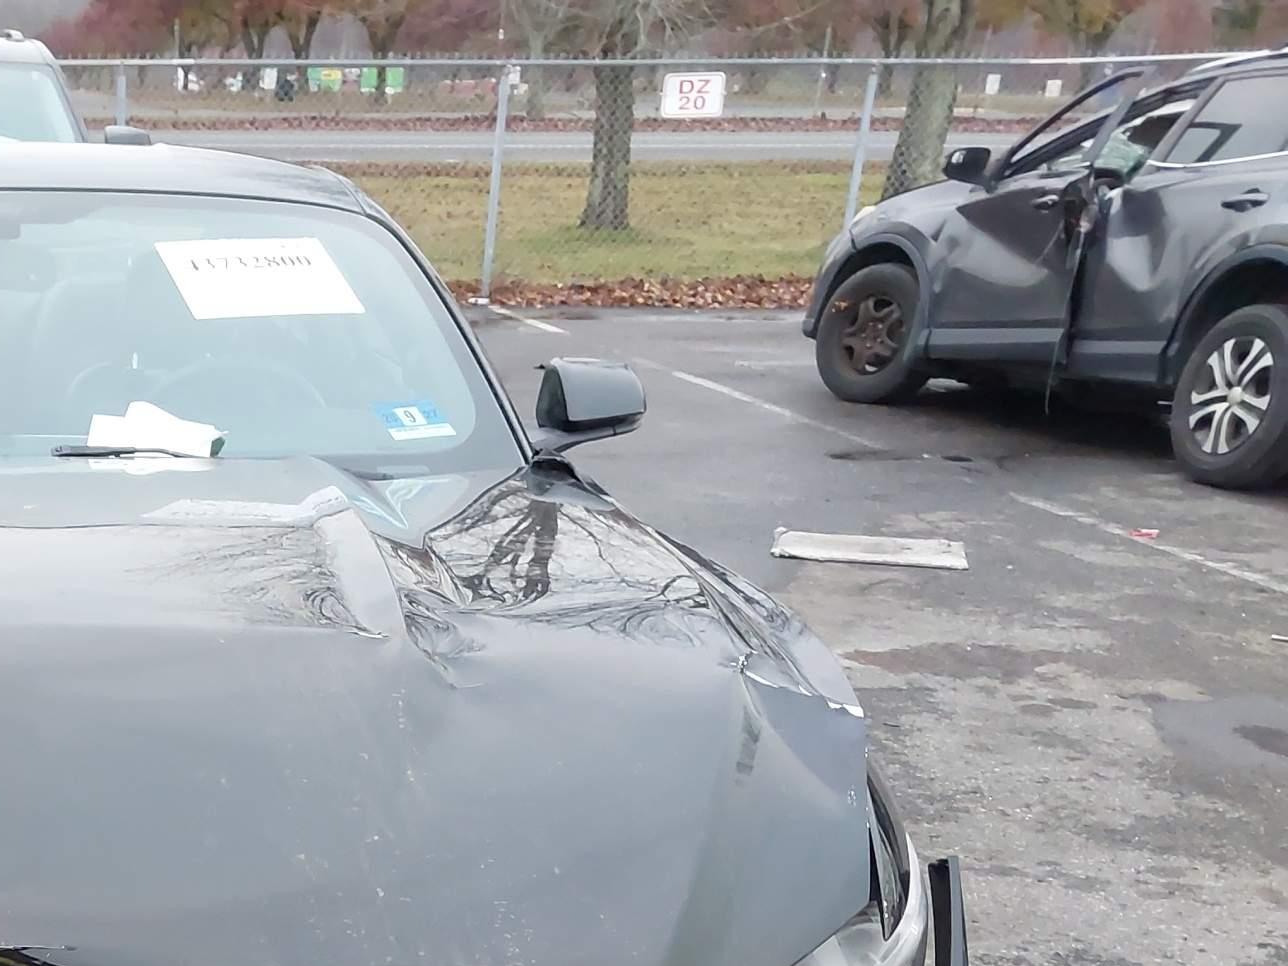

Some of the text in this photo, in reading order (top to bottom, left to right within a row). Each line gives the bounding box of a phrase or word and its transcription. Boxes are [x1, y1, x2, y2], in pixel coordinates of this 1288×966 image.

[679, 79, 711, 94] DZ
[678, 95, 706, 110] 20
[403, 409, 417, 423] 9
